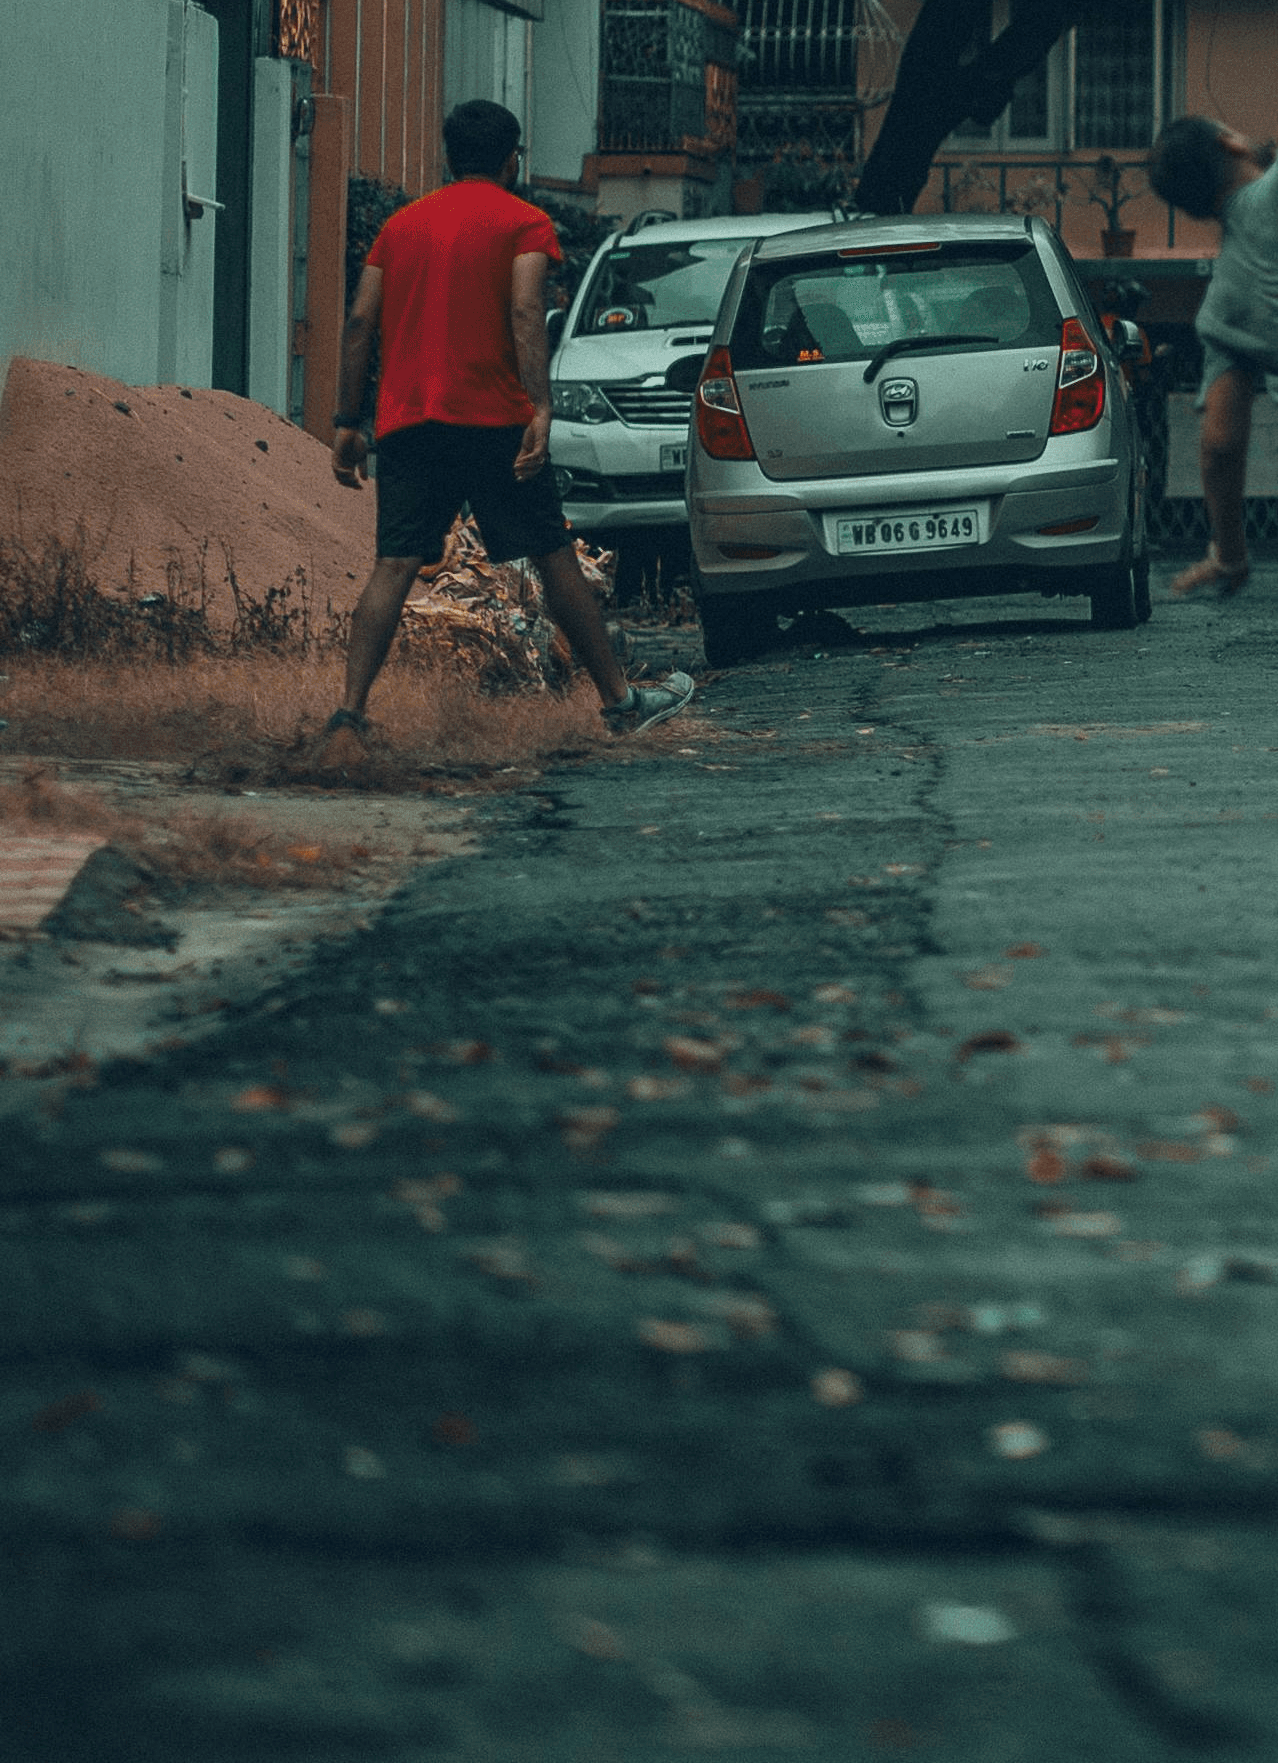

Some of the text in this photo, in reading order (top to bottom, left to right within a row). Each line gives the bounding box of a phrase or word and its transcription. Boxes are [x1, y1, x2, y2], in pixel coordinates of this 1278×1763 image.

[852, 524, 876, 545] WB
[880, 522, 905, 543] 06
[925, 517, 973, 539] 9649
